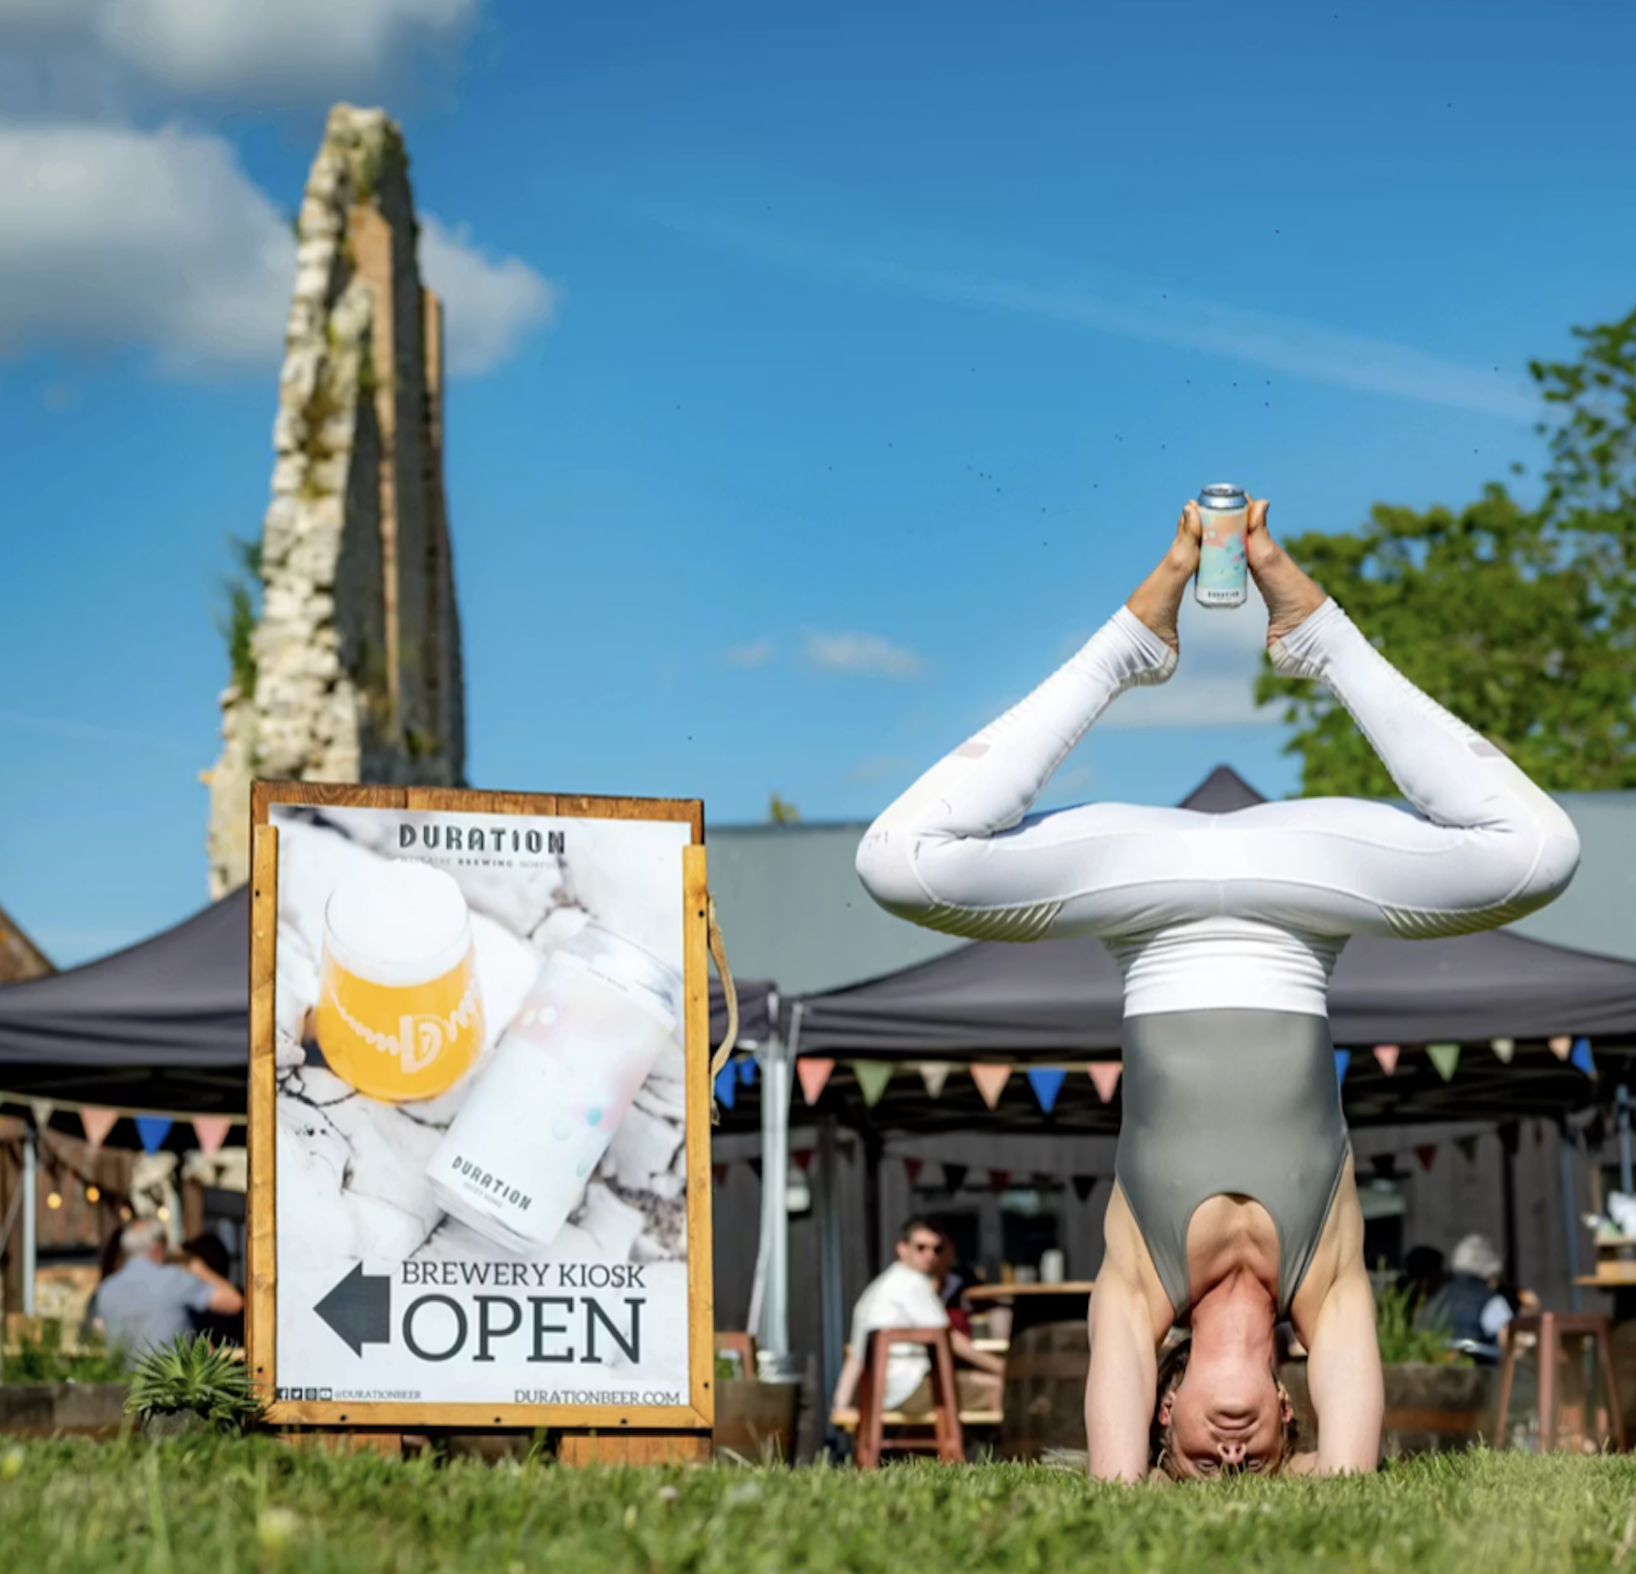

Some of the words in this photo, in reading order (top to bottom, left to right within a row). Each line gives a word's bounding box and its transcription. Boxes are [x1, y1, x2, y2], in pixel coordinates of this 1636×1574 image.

[399, 823, 565, 854] DURATION
[451, 1155, 532, 1211] DURATION
[401, 1260, 551, 1287] BREWERY
[558, 1263, 647, 1289] KIOSK
[402, 1293, 647, 1365] OPEN
[334, 1388, 422, 1400] @DURATIONBEER
[514, 1389, 681, 1406] DURATIONBEER.COM
